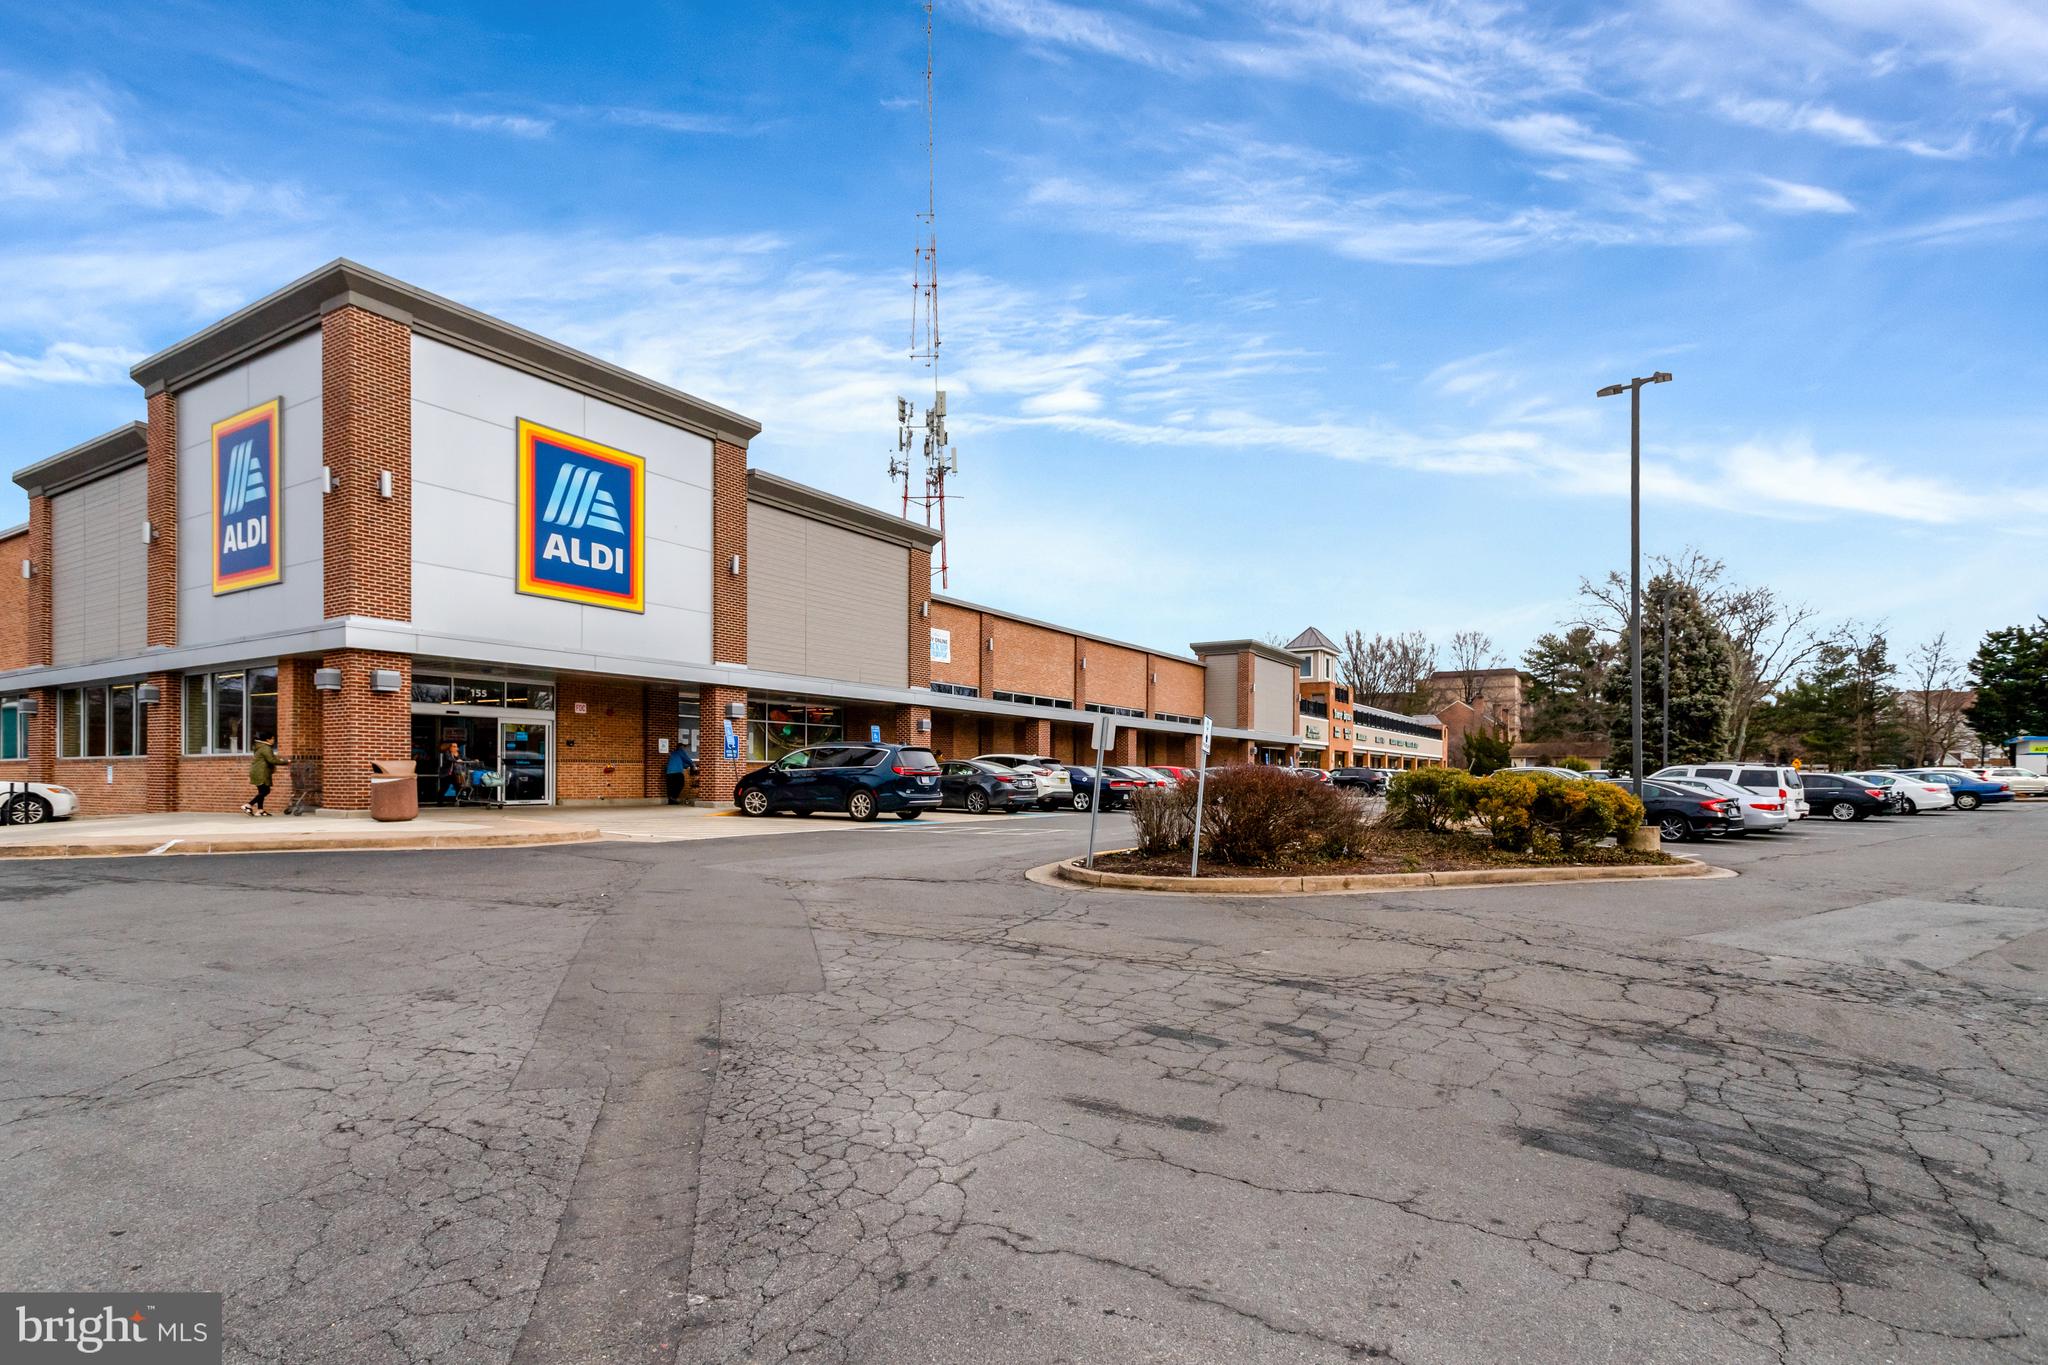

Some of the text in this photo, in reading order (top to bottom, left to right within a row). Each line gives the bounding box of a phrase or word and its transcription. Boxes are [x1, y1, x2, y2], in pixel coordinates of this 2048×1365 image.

[223, 515, 267, 554] ALDI
[542, 533, 624, 574] ALDI
[471, 689, 487, 698] 155
